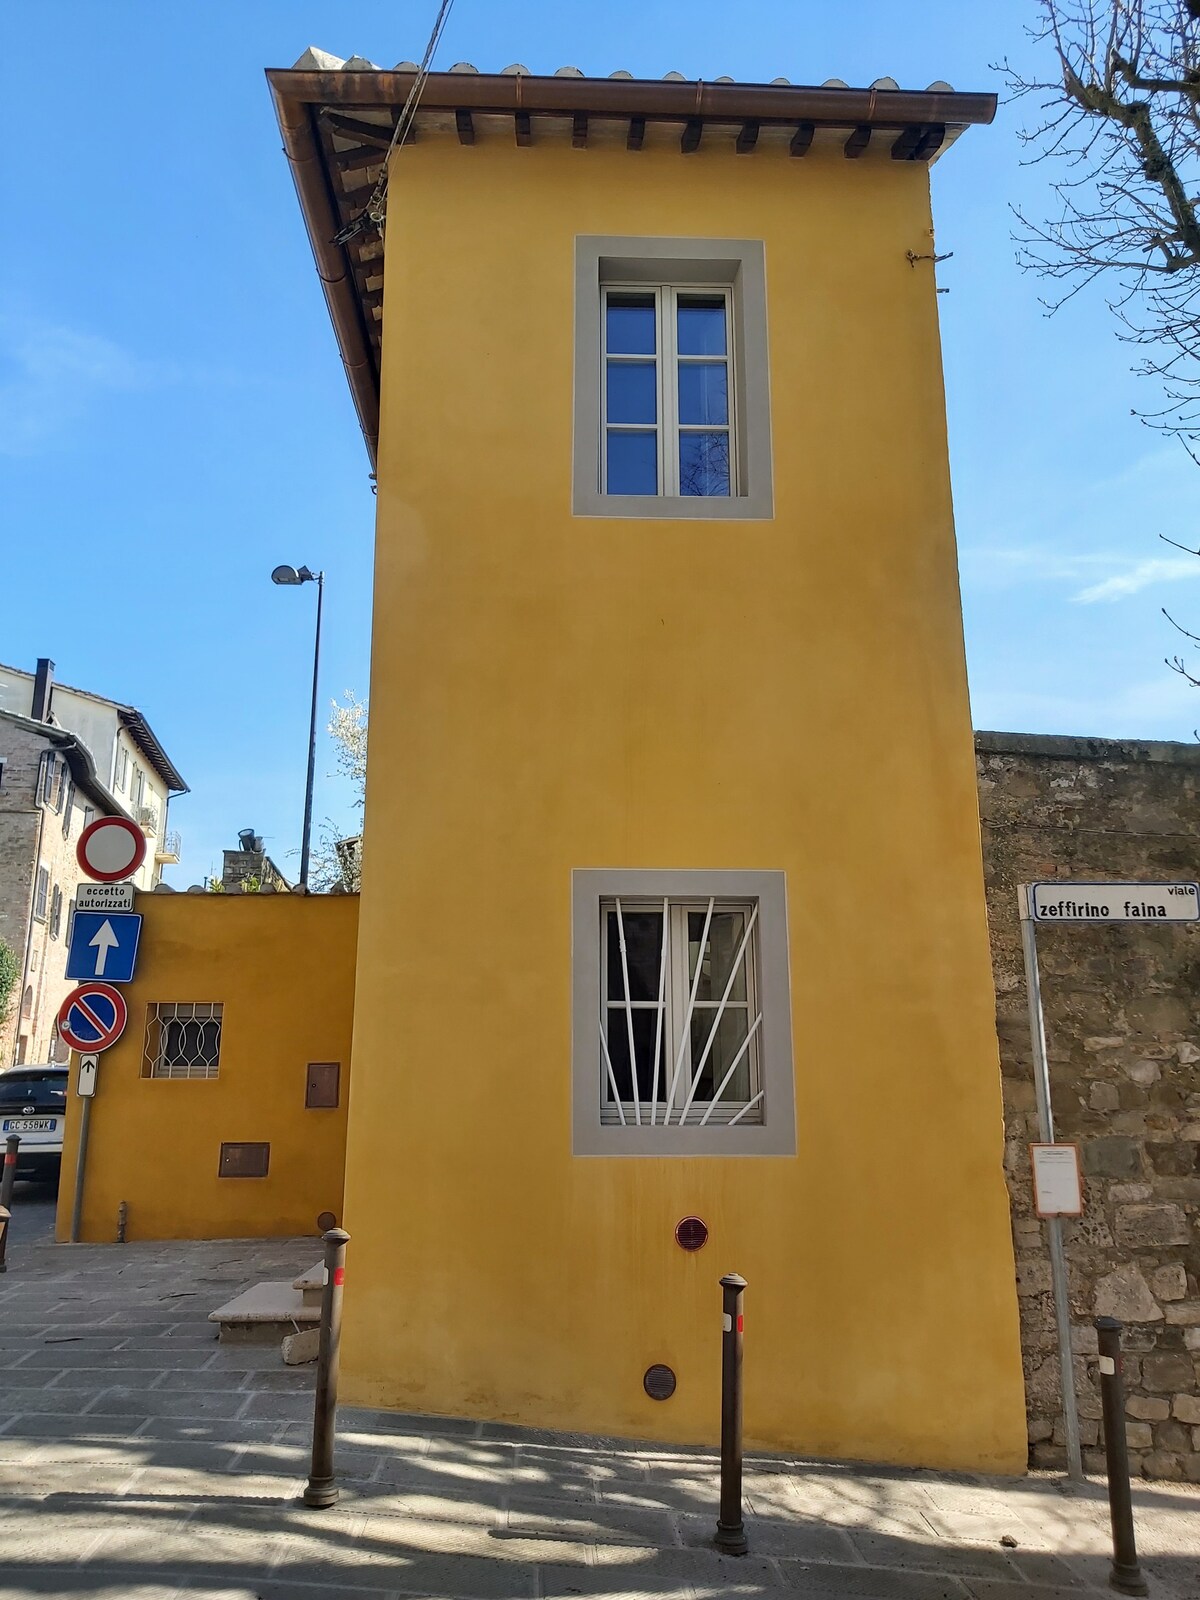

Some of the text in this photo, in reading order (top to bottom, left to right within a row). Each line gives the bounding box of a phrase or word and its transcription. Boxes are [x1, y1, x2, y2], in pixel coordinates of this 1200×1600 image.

[86, 886, 125, 896] eccetto
[1168, 886, 1195, 895] viale
[79, 898, 131, 908] autorizzati
[1040, 901, 1167, 918] zeffirino faina
